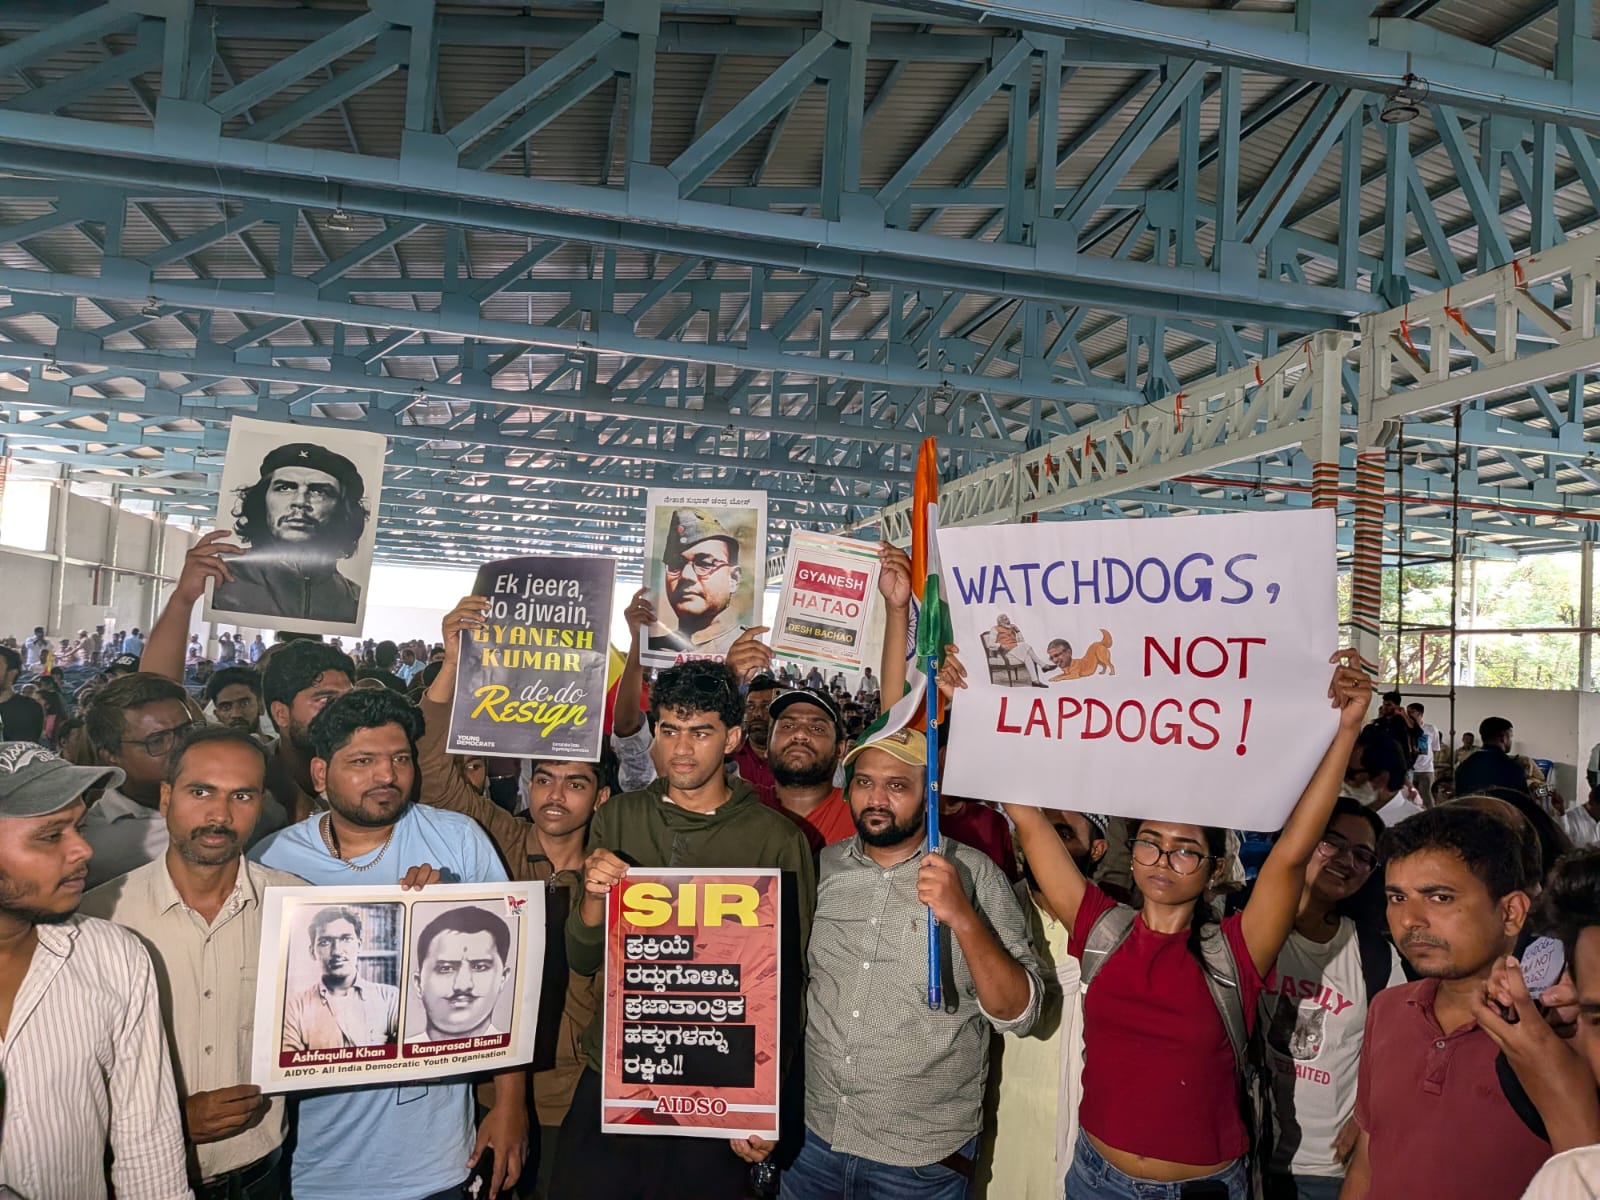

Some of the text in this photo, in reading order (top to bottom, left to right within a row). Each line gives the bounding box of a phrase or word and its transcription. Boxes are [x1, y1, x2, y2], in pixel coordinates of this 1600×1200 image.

[494, 573, 584, 602] Ek jeera,
[798, 569, 865, 592] GYANESH
[952, 552, 1281, 606] WATCHDOGS,
[514, 598, 591, 629] ajwain,
[791, 592, 860, 619] HATAO
[473, 624, 594, 650] GYANESH
[788, 623, 853, 643] DESH BACHAO
[481, 648, 581, 672] KUMAR
[1143, 635, 1266, 679] NOT
[520, 679, 587, 703] de do
[471, 685, 588, 738] Resign
[996, 696, 1253, 757] LAPDOGS!
[456, 740, 495, 748] DEMOCRATS
[622, 882, 760, 927] SIR
[626, 934, 690, 960] ಪ್ರಕ್ರಿಯೆ
[626, 964, 739, 993] ರದ್ದುಗೊಳಿಸಿ,
[625, 994, 745, 1022] ಪ್ರಜಾತಾಂತ್ರಿಕ
[411, 1034, 503, 1055] Ramprasad Bismil
[624, 1024, 730, 1054] ಹಕ್ಕುಗಳನ್ನು
[284, 1050, 507, 1078] AIDYO- All India Democratic Youth Organisation
[292, 1047, 386, 1063] Ashfaqulla Khan
[624, 1054, 684, 1083] ರಕ್ಷಿಸಿ!!
[655, 1096, 728, 1116] AIDSO
